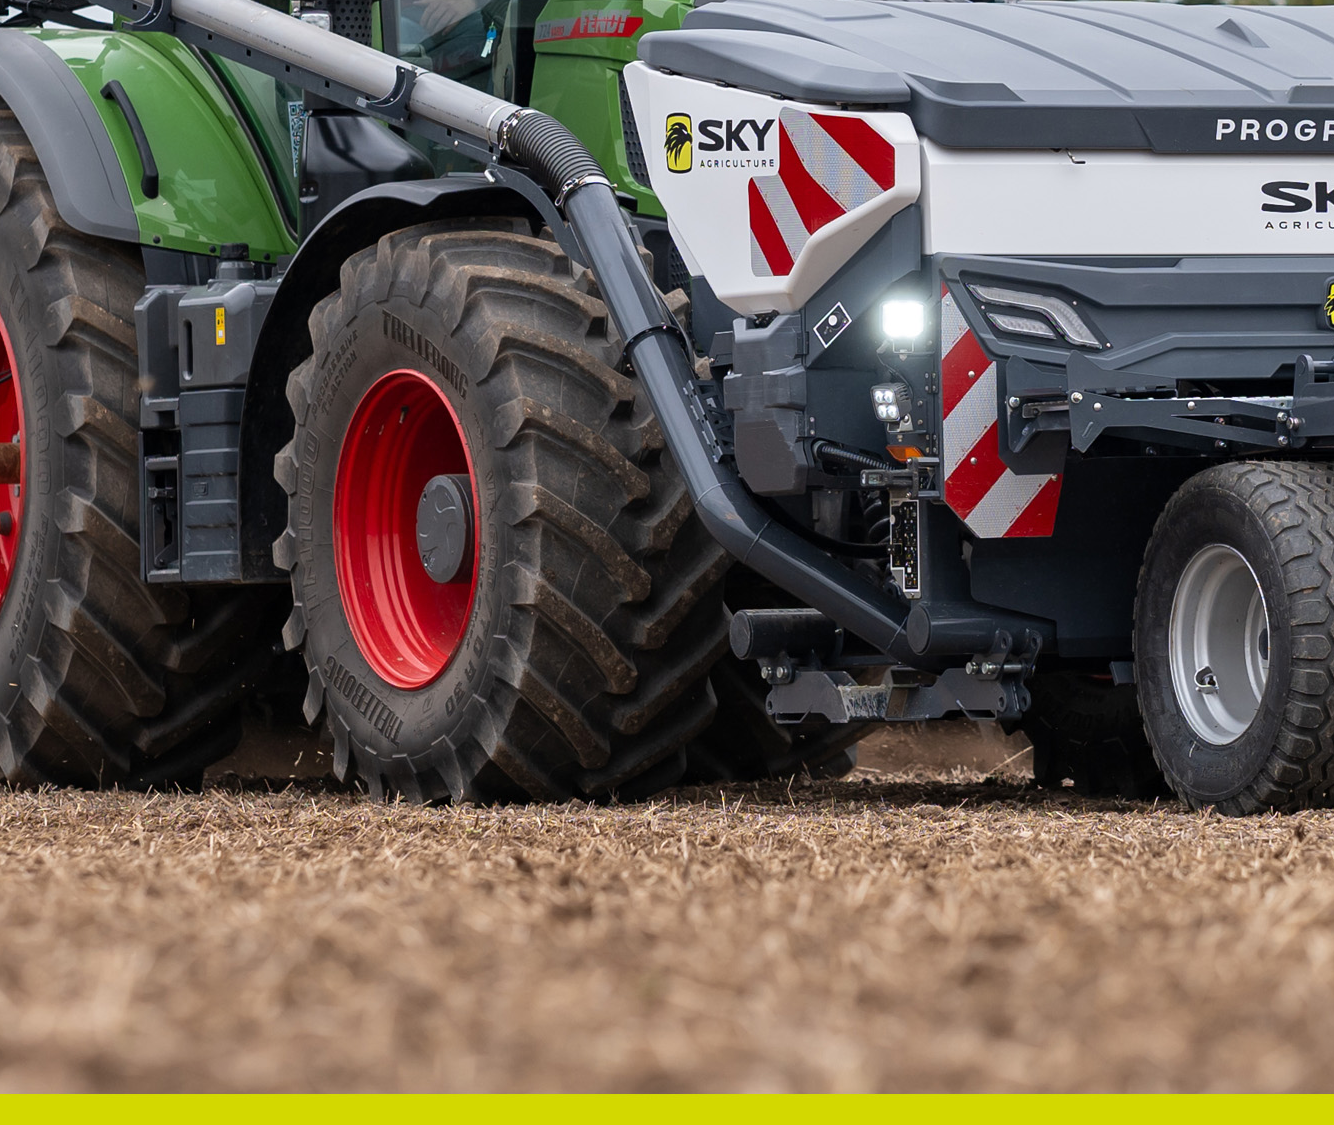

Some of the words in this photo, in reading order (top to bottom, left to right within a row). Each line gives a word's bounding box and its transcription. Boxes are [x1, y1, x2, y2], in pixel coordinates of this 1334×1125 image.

[580, 9, 631, 34] FENDT
[698, 119, 775, 152] SKY
[700, 159, 774, 168] AGRICULTURE
[383, 309, 468, 401] TRELLEBORG
[321, 350, 357, 415] TRACTION
[324, 655, 404, 748] TRELLEBORG
